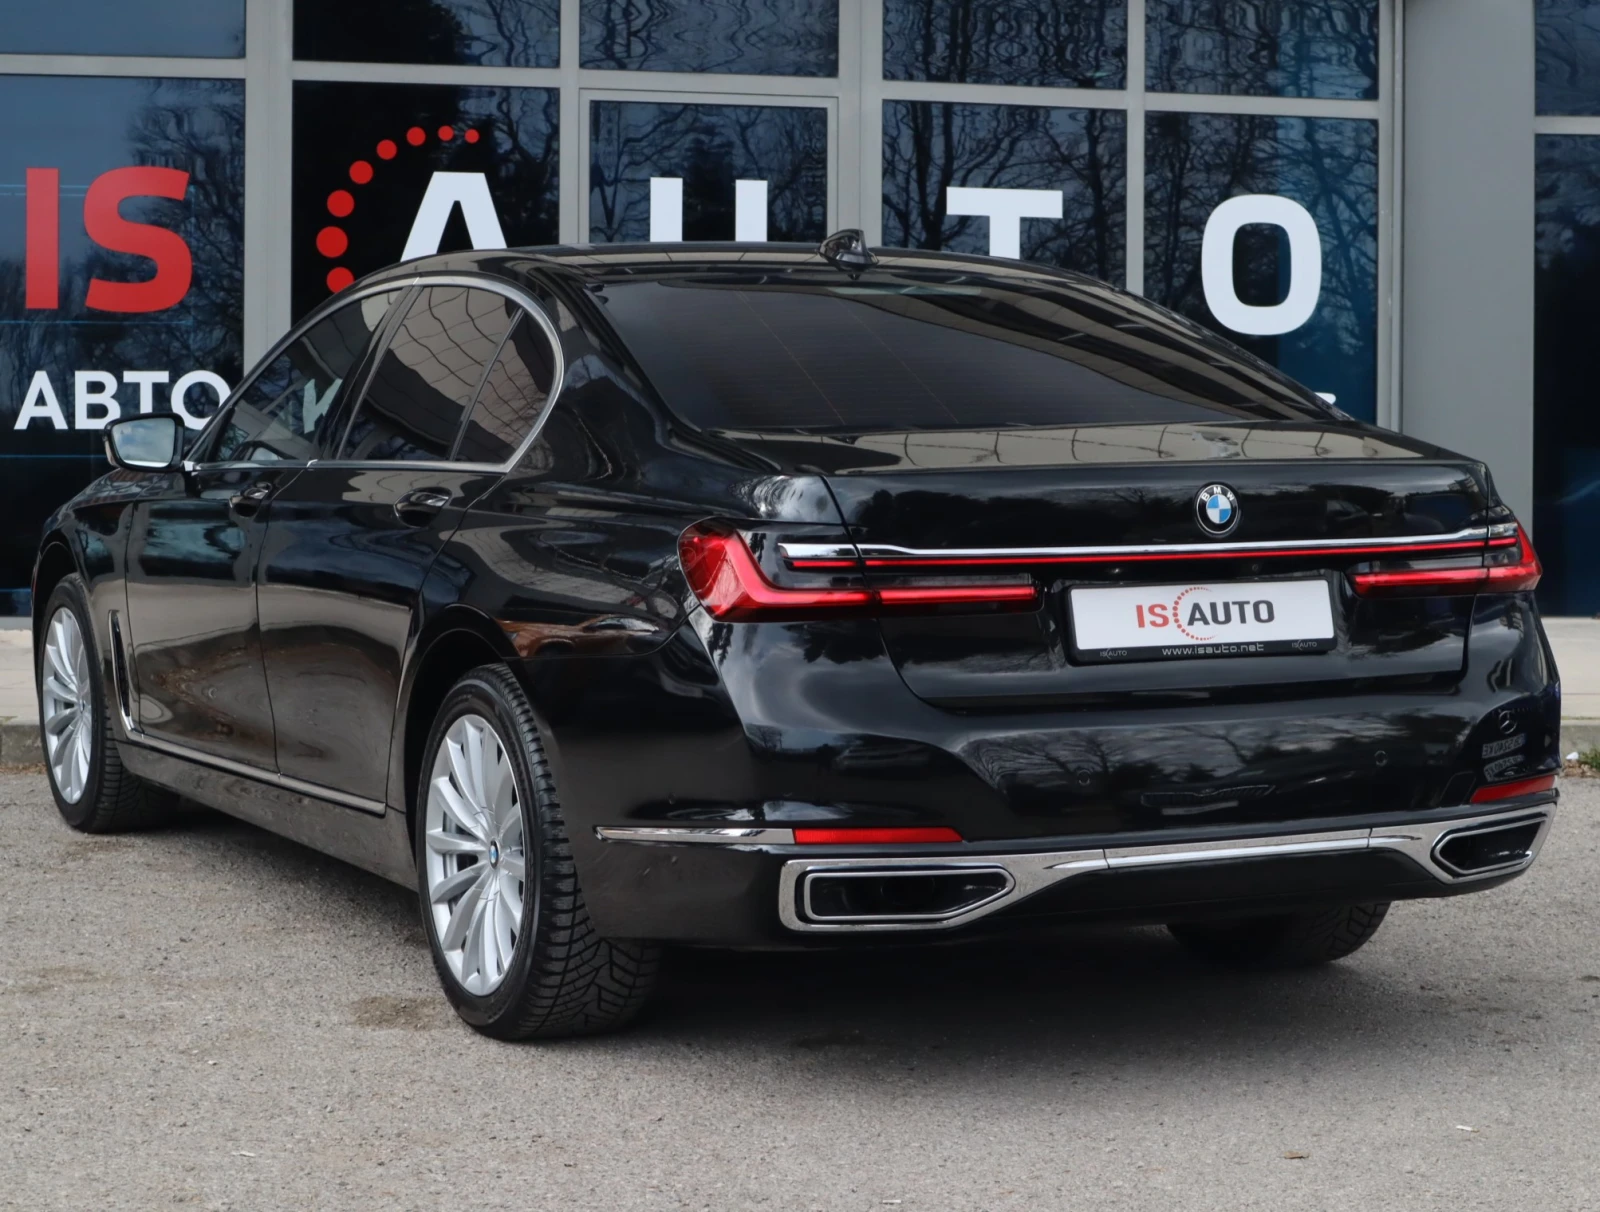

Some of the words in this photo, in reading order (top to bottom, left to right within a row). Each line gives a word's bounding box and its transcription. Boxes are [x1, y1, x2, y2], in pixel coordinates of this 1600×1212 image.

[25, 166, 193, 313] IS
[1201, 486, 1235, 502] BMW
[1135, 604, 1170, 628] IS
[1187, 600, 1275, 626] AUTO
[1162, 643, 1264, 655] www.isauto.net
